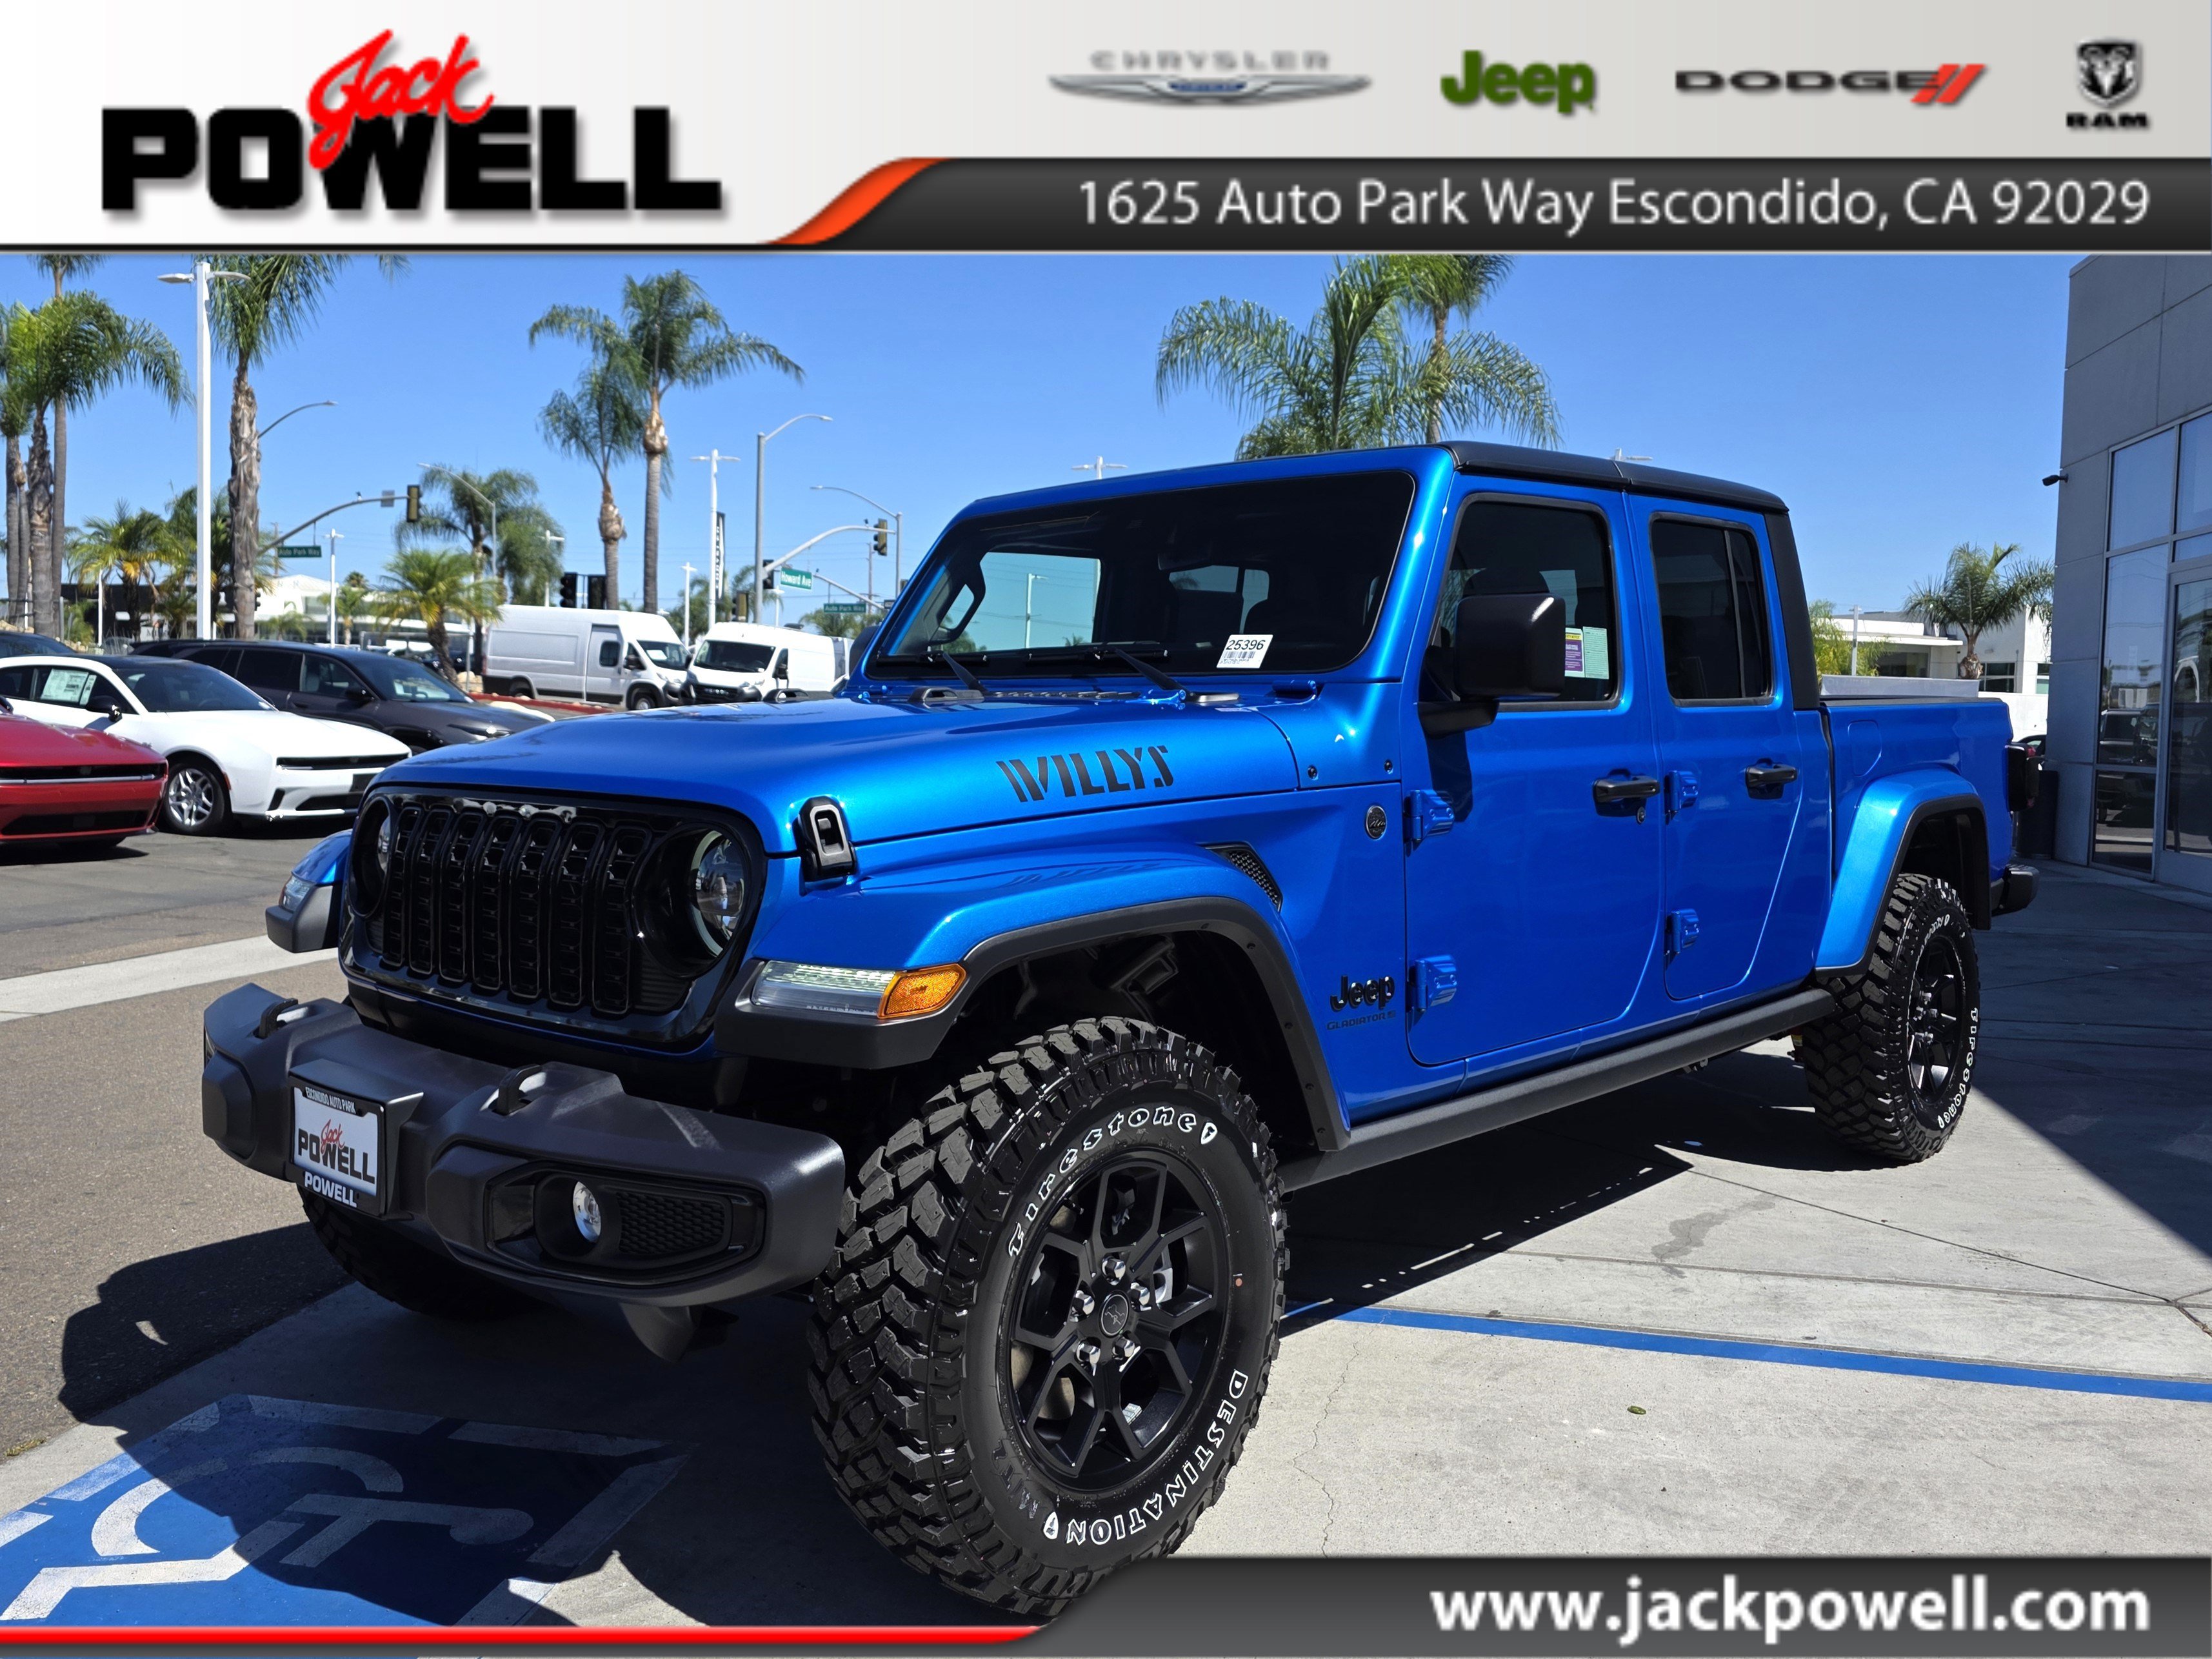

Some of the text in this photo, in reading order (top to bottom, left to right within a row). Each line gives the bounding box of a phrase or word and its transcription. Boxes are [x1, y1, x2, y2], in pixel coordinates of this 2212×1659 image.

[781, 571, 812, 587] Howard Ave
[1226, 639, 1266, 650] 25396
[995, 745, 1174, 803] WILLYS
[1330, 976, 1395, 1012] Jeep
[1326, 1012, 1386, 1031] GLADIATOR
[329, 1095, 343, 1110] AUTO
[341, 1099, 356, 1114] PARK
[321, 1119, 345, 1154] Jack
[298, 1128, 375, 1185] POWELL
[304, 1171, 357, 1208] POWELL
[1066, 1369, 1249, 1546] DESTINATION
